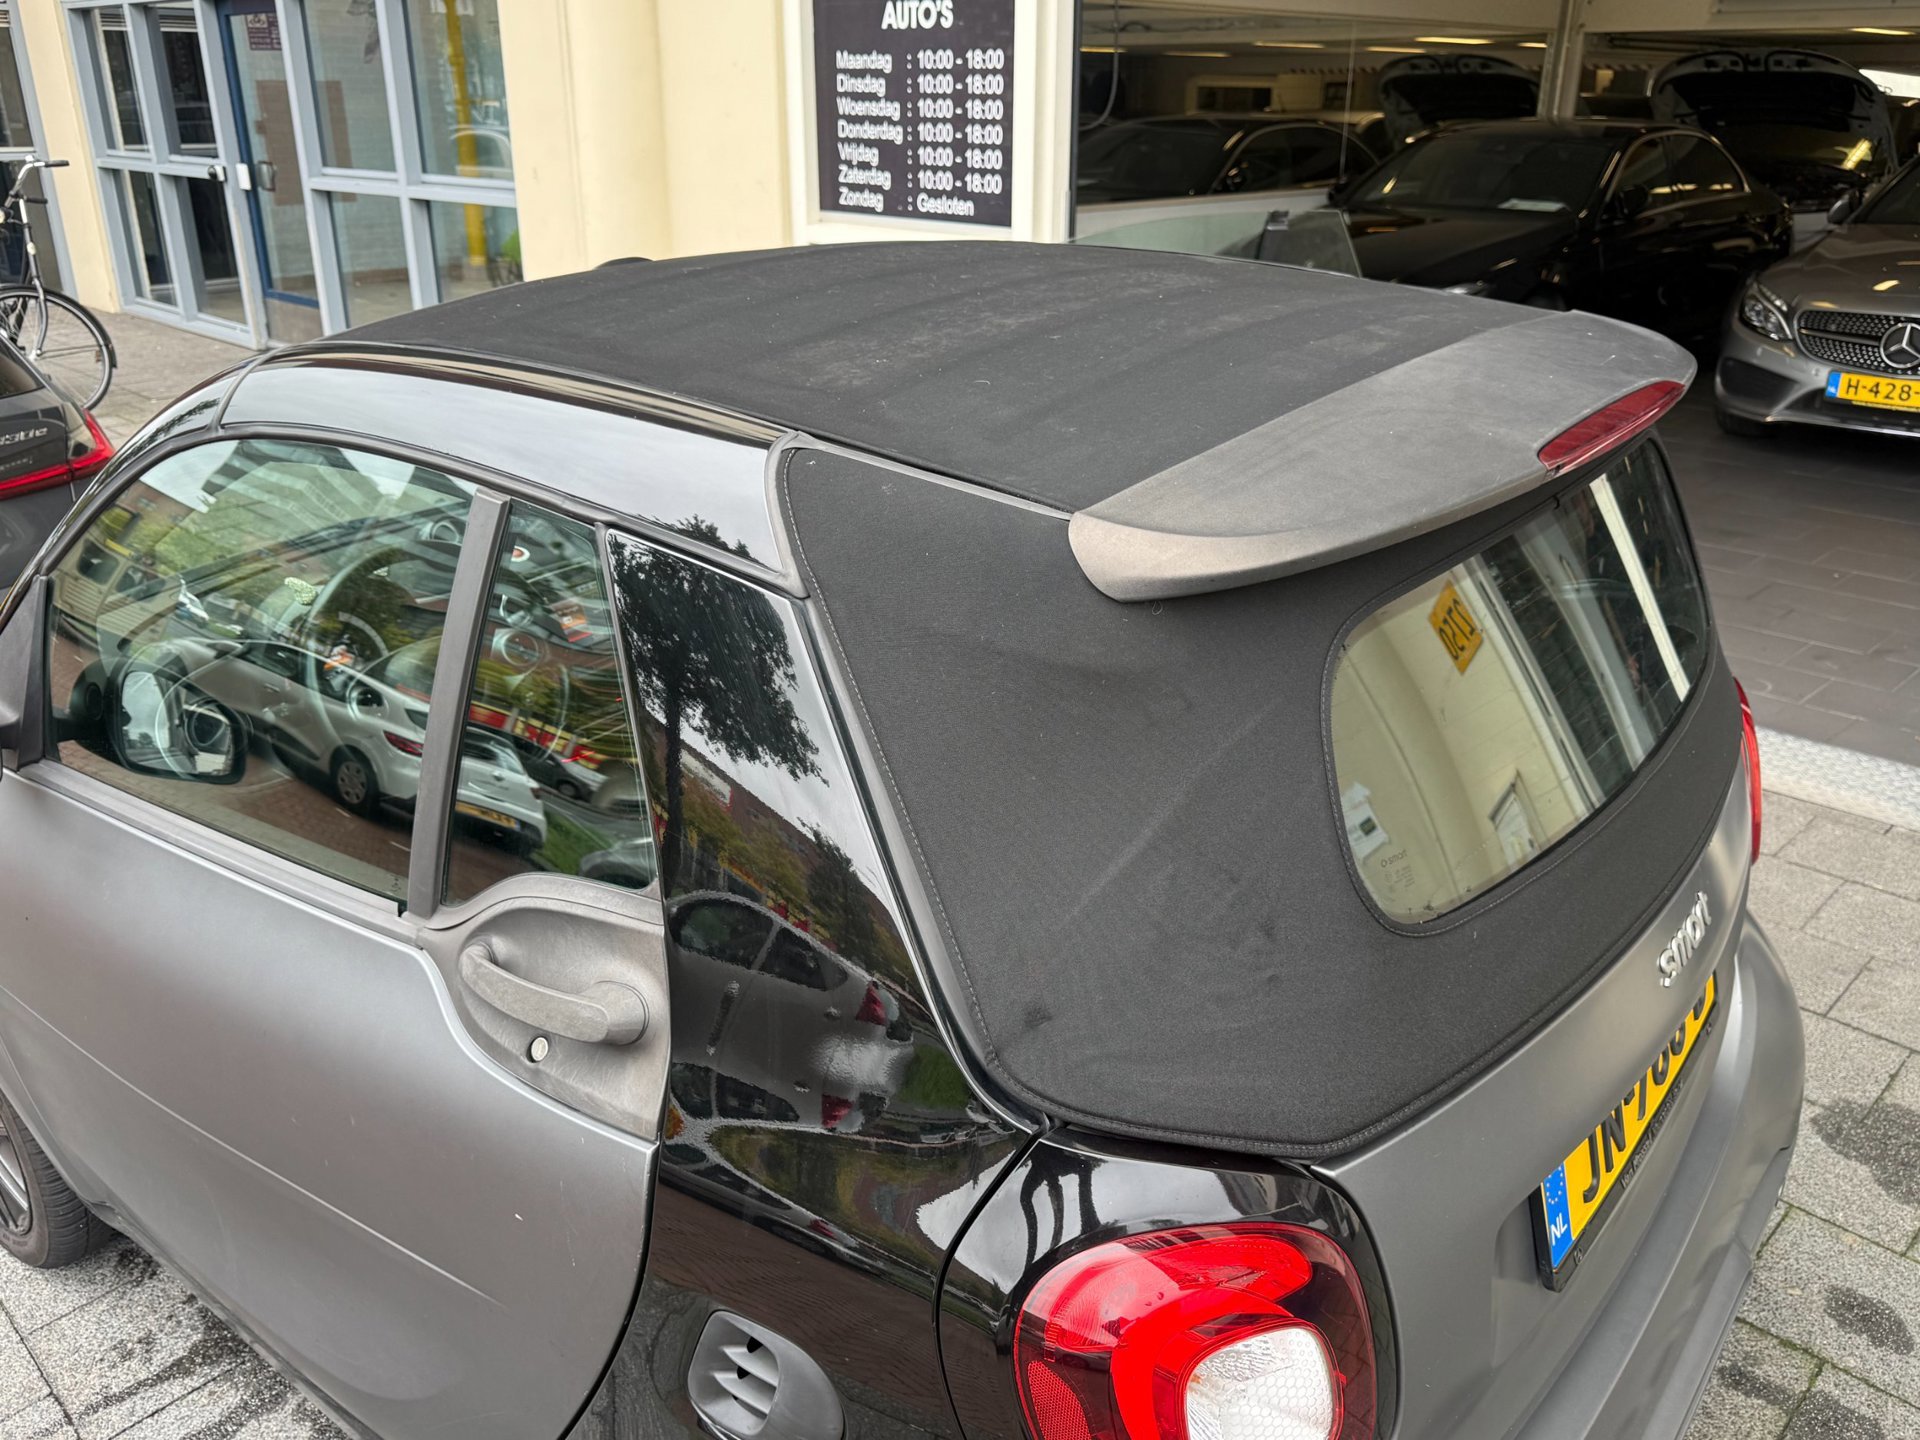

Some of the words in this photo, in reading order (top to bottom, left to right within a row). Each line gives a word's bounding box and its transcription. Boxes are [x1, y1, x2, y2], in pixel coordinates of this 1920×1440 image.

[881, 1, 953, 29] AUTO'S
[836, 50, 892, 73] Maandag
[917, 49, 954, 69] 10:00
[965, 48, 1004, 69] 18:00
[836, 73, 886, 97] Dinsdag
[917, 74, 954, 94] 10:00
[965, 74, 1004, 95] 18:00
[836, 96, 901, 121] Woensdag
[917, 98, 953, 118] 10:00
[965, 99, 1003, 120] 18:00
[837, 118, 903, 145] Donderdag
[917, 122, 953, 143] 10:00
[965, 124, 1003, 145] 18:00
[837, 142, 879, 167] Vrijdag
[917, 146, 953, 167] 10:00
[965, 148, 1002, 170] 18:00
[838, 163, 892, 189] Zaterdag
[917, 170, 953, 191] 10:00
[965, 173, 1002, 194] 18:00
[838, 186, 884, 212] Zondag
[917, 192, 975, 216] Gesloten
[1658, 891, 1712, 988] smart
[1550, 1213, 1568, 1246] NL
